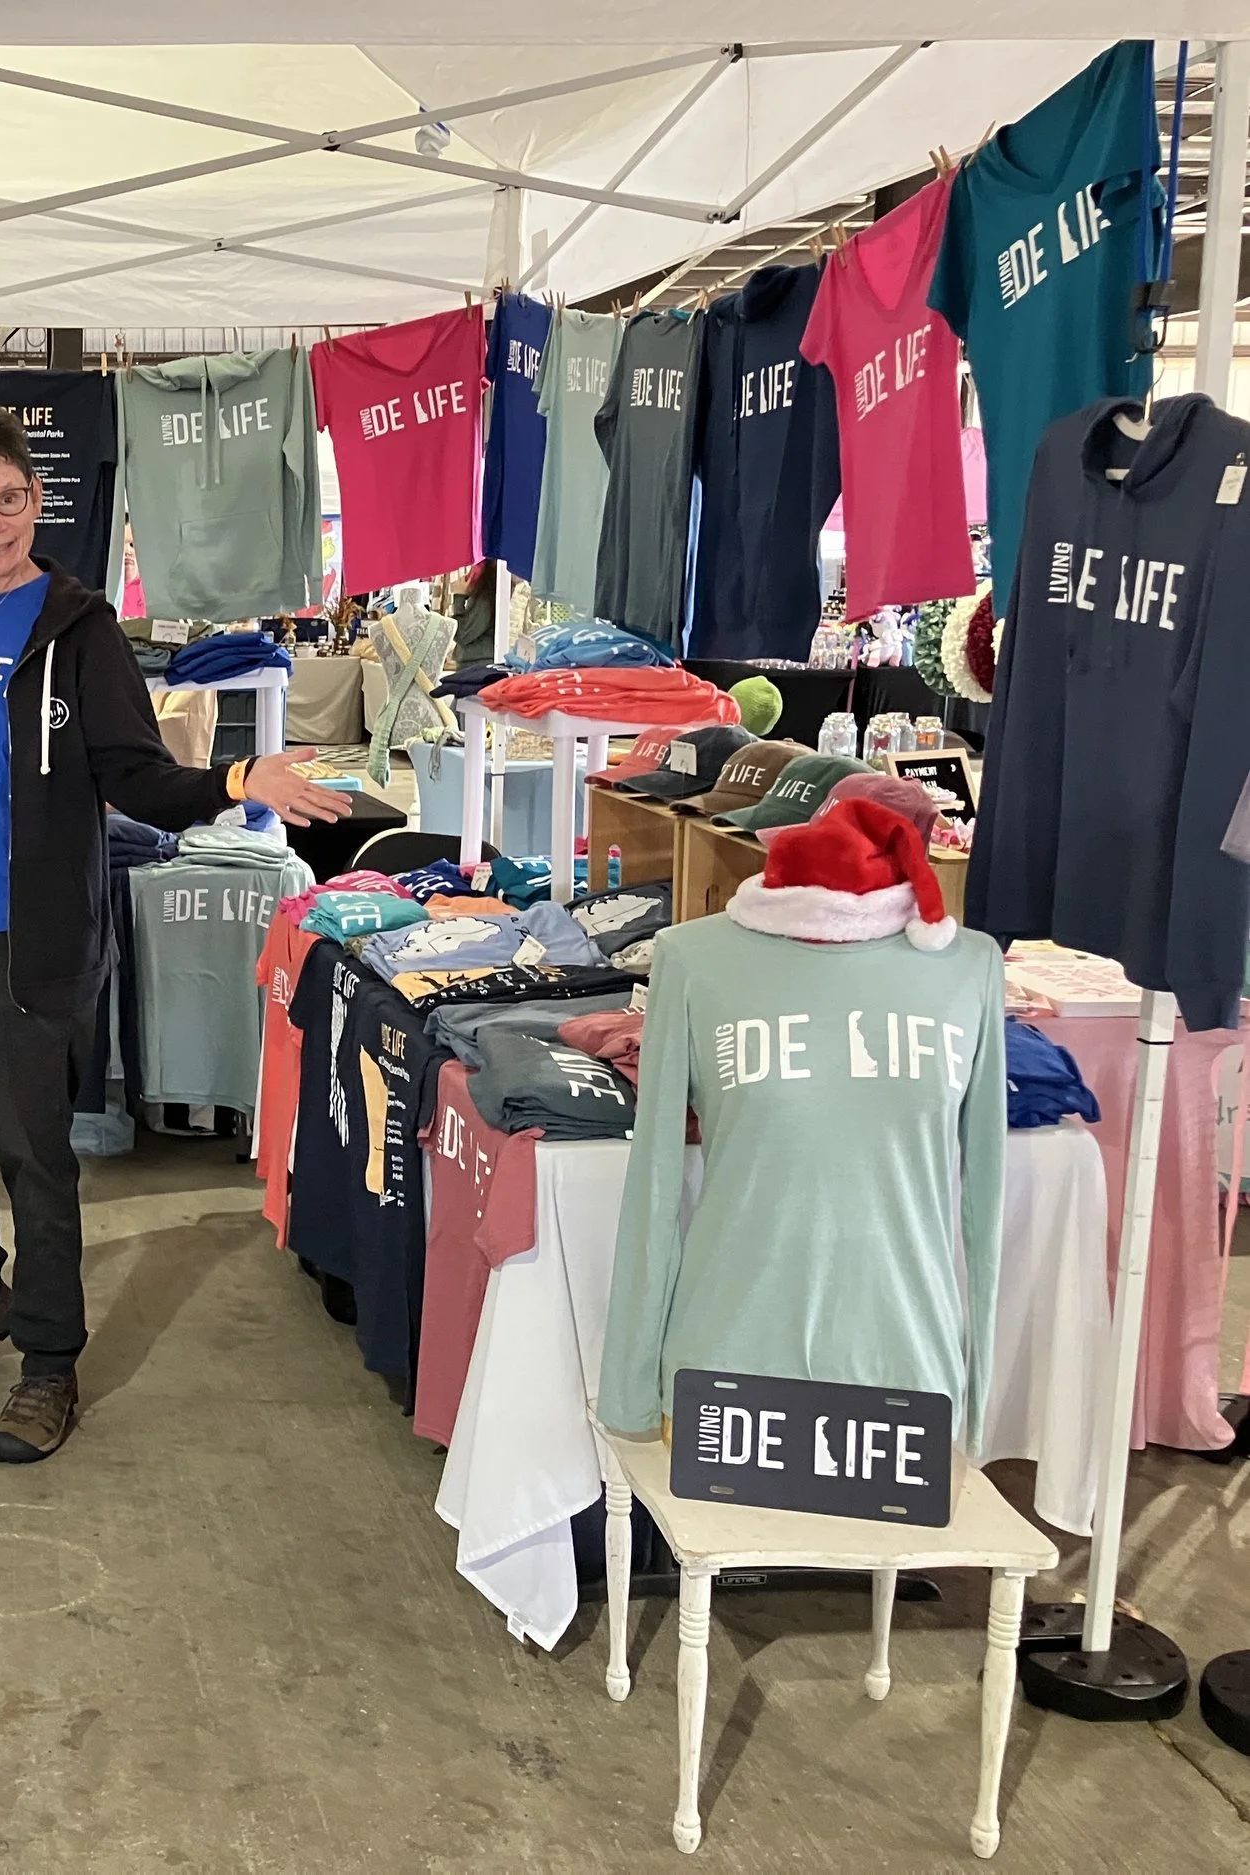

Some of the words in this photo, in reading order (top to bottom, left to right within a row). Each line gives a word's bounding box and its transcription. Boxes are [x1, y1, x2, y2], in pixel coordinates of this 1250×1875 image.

[997, 250, 1015, 309] LIVING
[1010, 221, 1049, 300] DE
[584, 356, 609, 398] LIFE
[636, 367, 656, 406] DE
[657, 367, 684, 412] LIFE
[759, 360, 795, 414] LIFE
[860, 350, 886, 414] DE
[22, 406, 54, 427] LIFE
[46, 429, 64, 438] Parks
[161, 413, 174, 447] LIVING
[172, 411, 203, 446] DE
[219, 397, 272, 440] LIFE
[359, 408, 374, 441] LIVING
[371, 396, 406, 438] DE
[413, 380, 467, 425] LIFE
[1048, 541, 1071, 604] LIVING
[1115, 554, 1185, 632] LIFE
[729, 763, 766, 787] LIFE
[776, 778, 817, 803] LIFE
[904, 766, 938, 777] PAYMENT
[163, 890, 175, 923] LIVING
[174, 888, 209, 922] DE
[222, 887, 275, 929] LIFE
[272, 966, 284, 1004] LIVING
[715, 1022, 737, 1091] LIVING
[736, 1013, 812, 1085] DE
[848, 1010, 965, 1092] LIFE
[549, 1050, 626, 1106] LIFE
[443, 1105, 466, 1171] DE
[697, 1404, 722, 1464] LIVING
[720, 1406, 787, 1471] DE
